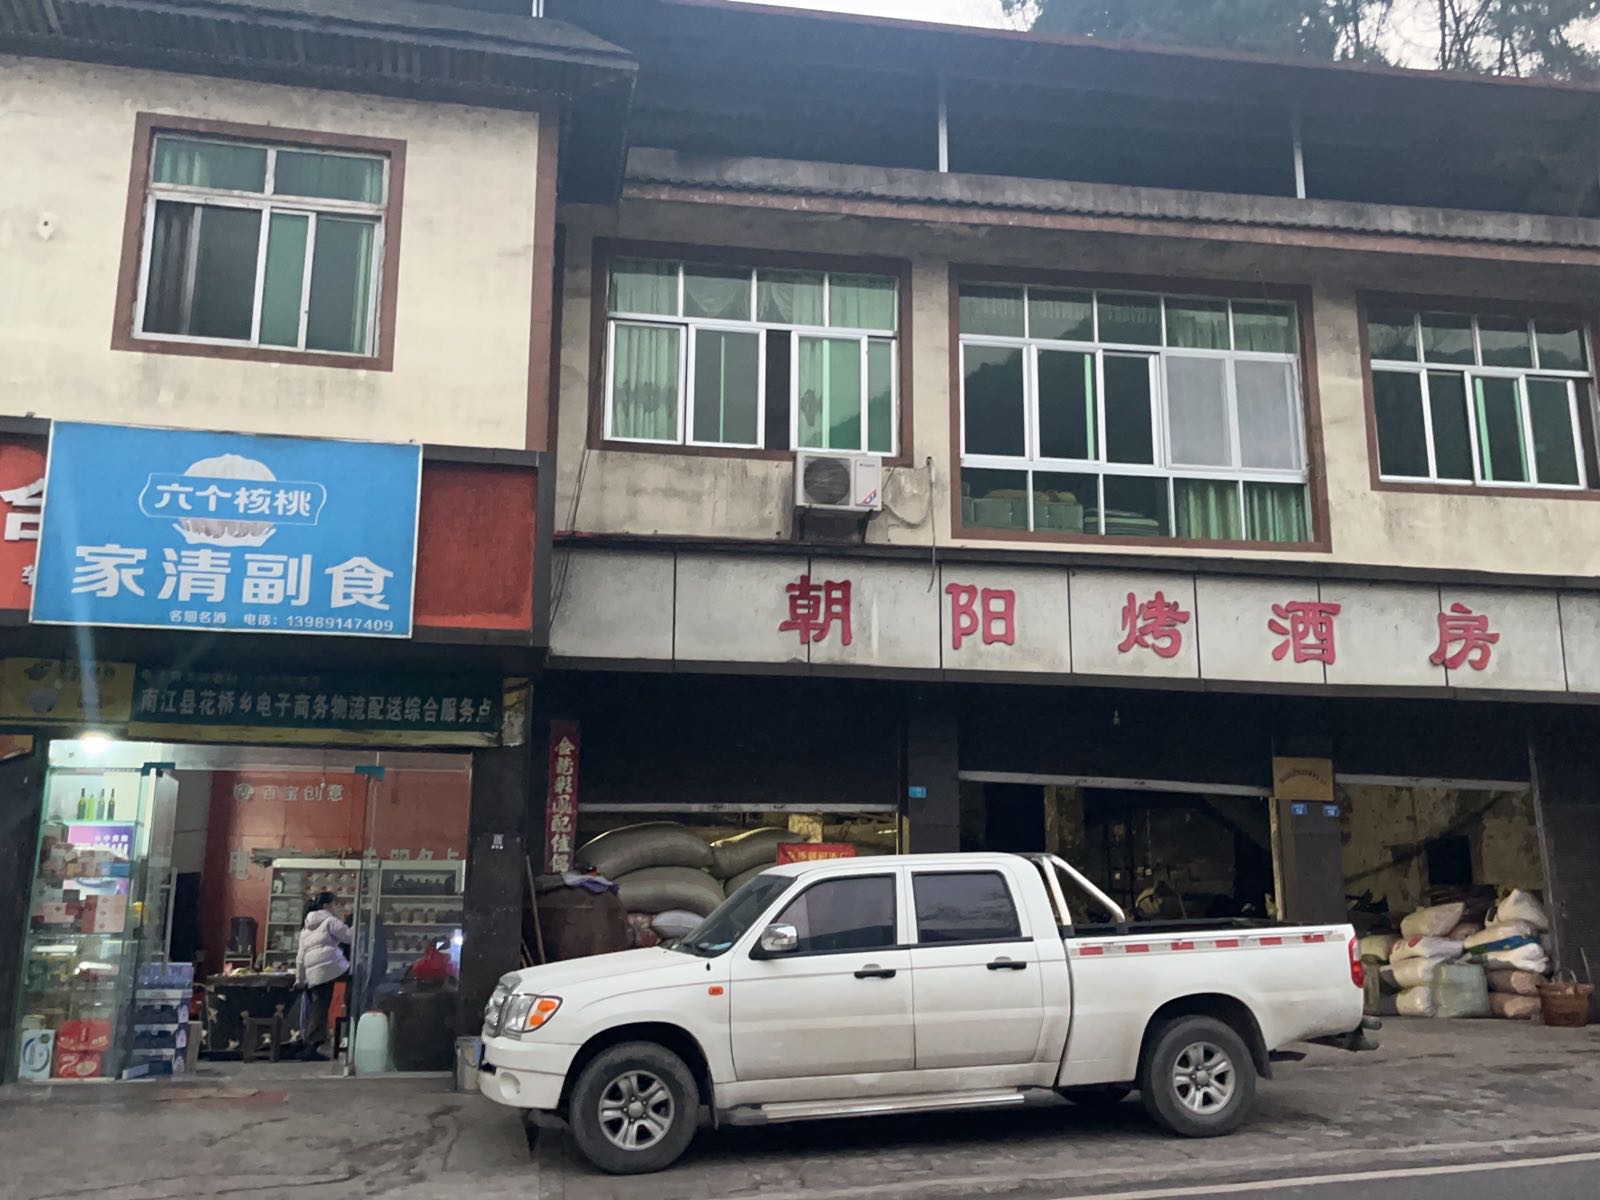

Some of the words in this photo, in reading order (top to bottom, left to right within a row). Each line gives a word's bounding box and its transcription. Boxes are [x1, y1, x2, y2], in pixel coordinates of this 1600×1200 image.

[155, 481, 312, 517] 六个核桃
[71, 543, 393, 611] 家清副食
[169, 609, 227, 624] 名烟名酒
[286, 615, 395, 632] 13989147409
[778, 574, 1501, 672] 朝阳烤酒房
